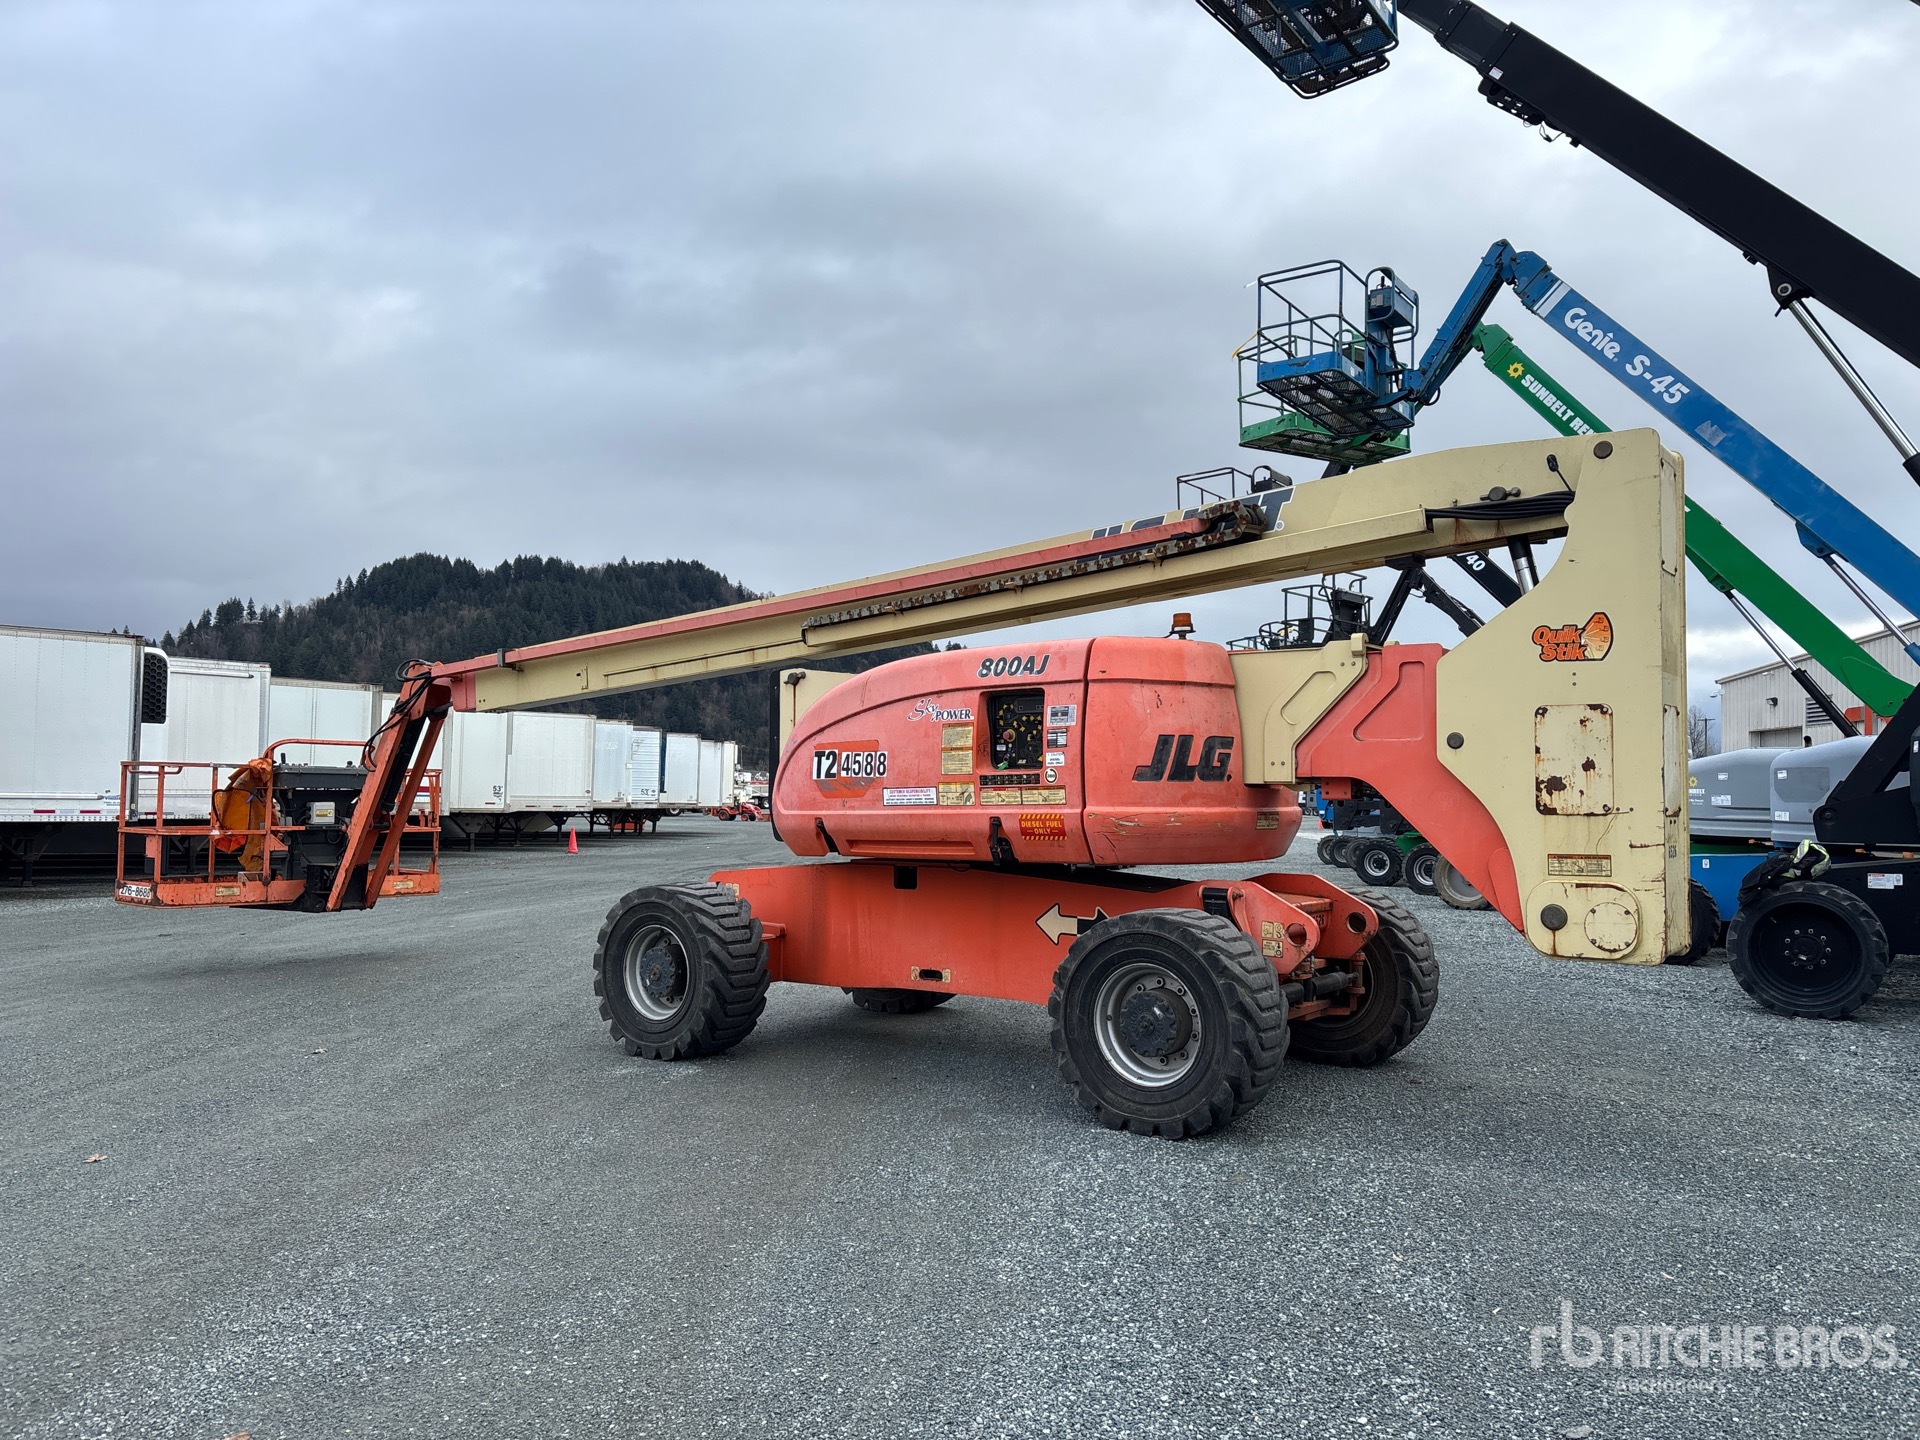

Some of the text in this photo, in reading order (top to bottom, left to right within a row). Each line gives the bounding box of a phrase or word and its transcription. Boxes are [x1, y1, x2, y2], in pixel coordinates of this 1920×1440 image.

[1564, 307, 1690, 404] Genie S-45
[1520, 374, 1575, 422] SUNBELT
[1533, 625, 1582, 647] Quik
[1540, 642, 1586, 661] Stik
[977, 654, 1050, 678] 800AJ
[908, 698, 973, 721] Sky POWER
[814, 750, 887, 779] T2 4588
[1132, 734, 1235, 782] JLG
[1021, 820, 1063, 828] DIESEL FUEL
